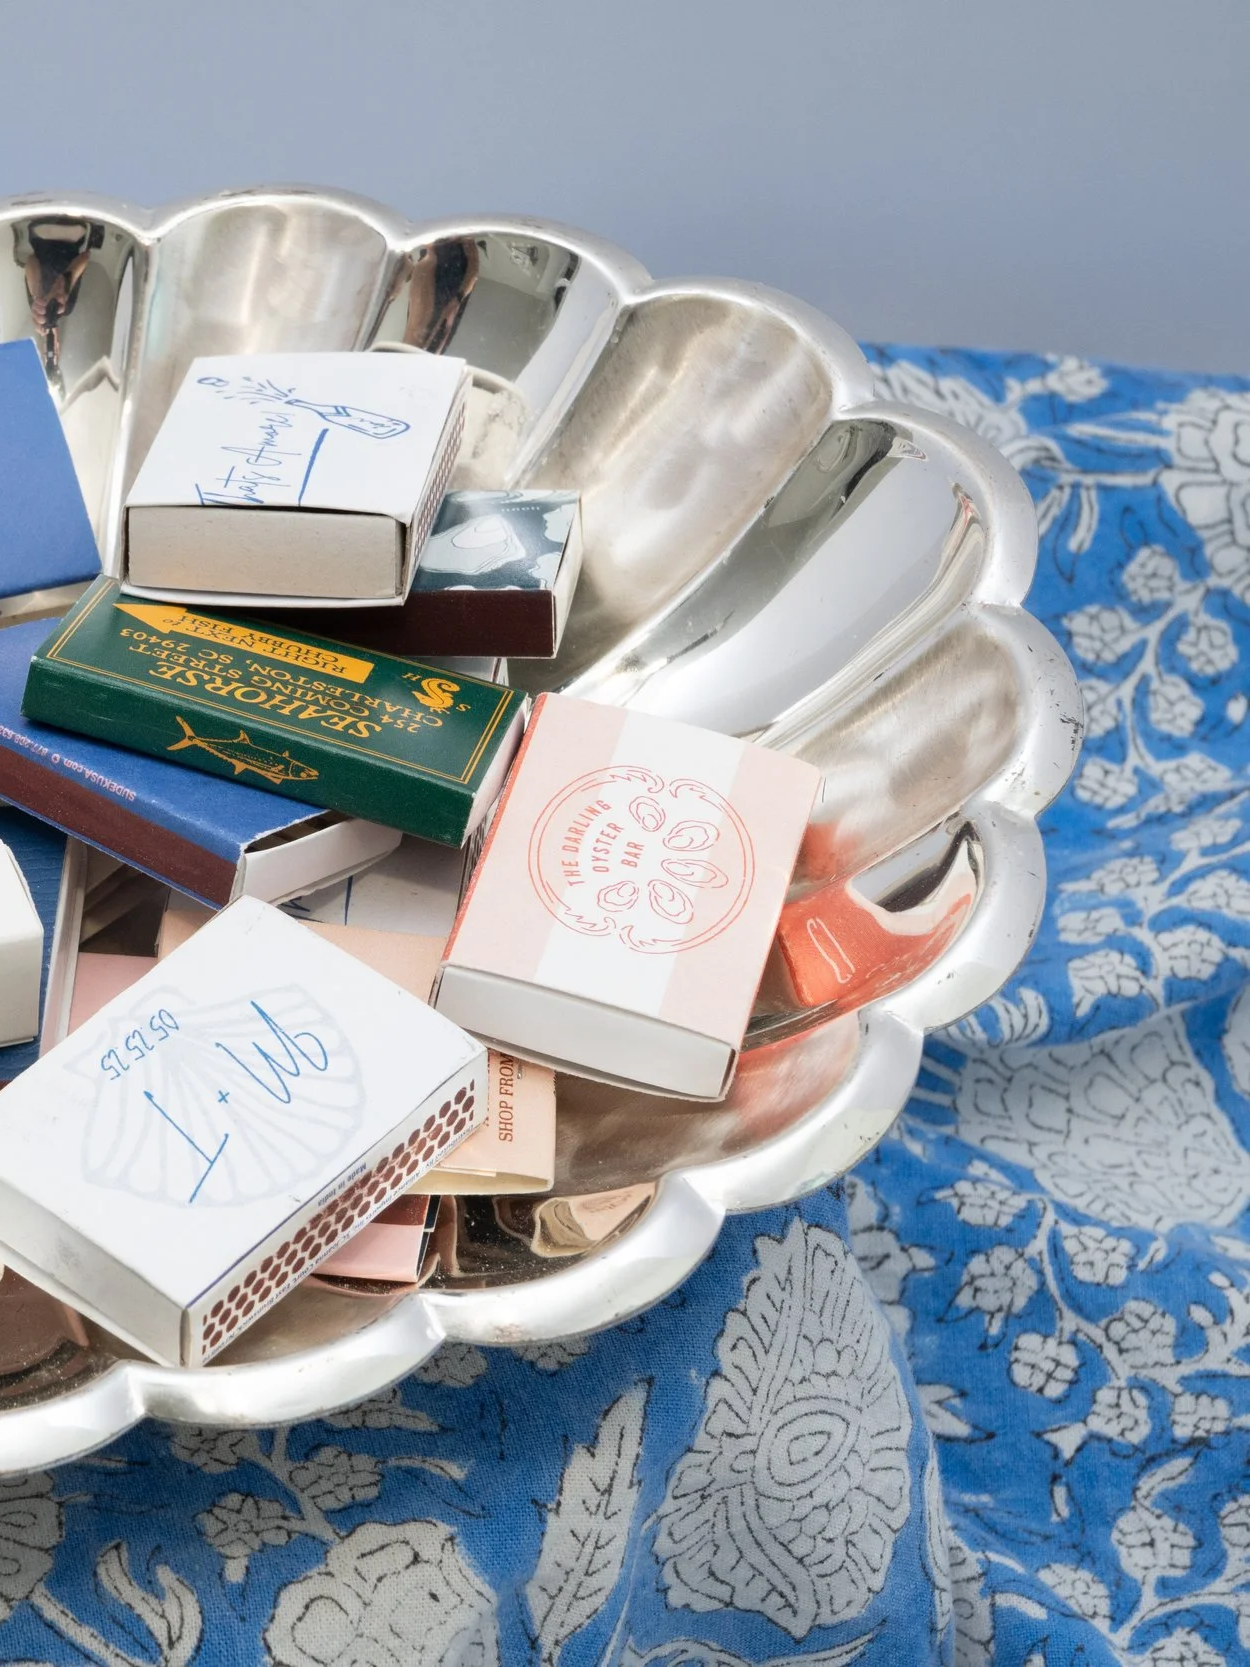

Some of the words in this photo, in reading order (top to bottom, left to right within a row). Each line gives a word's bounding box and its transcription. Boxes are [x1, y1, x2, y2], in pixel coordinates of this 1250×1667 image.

[162, 617, 181, 627] to
[181, 615, 233, 634] FISH
[120, 628, 190, 652] 29403
[186, 626, 258, 649] NEXT
[243, 632, 340, 664] CHUBBY
[129, 643, 243, 680] STREET
[198, 649, 234, 664] SC
[263, 647, 348, 674] RIGHT
[149, 661, 383, 739] SEAHORSE
[246, 659, 443, 727] CHARLESTON,
[251, 675, 370, 717] COMING
[380, 714, 421, 733] 254
[562, 800, 612, 853] DARLING
[591, 822, 625, 873] OYSTER
[621, 841, 645, 869] BAR
[561, 860, 586, 886] THE
[499, 1053, 515, 1097] FROM
[217, 1089, 230, 1104] +
[498, 1100, 514, 1142] SHOP
[143, 1090, 229, 1203] T
